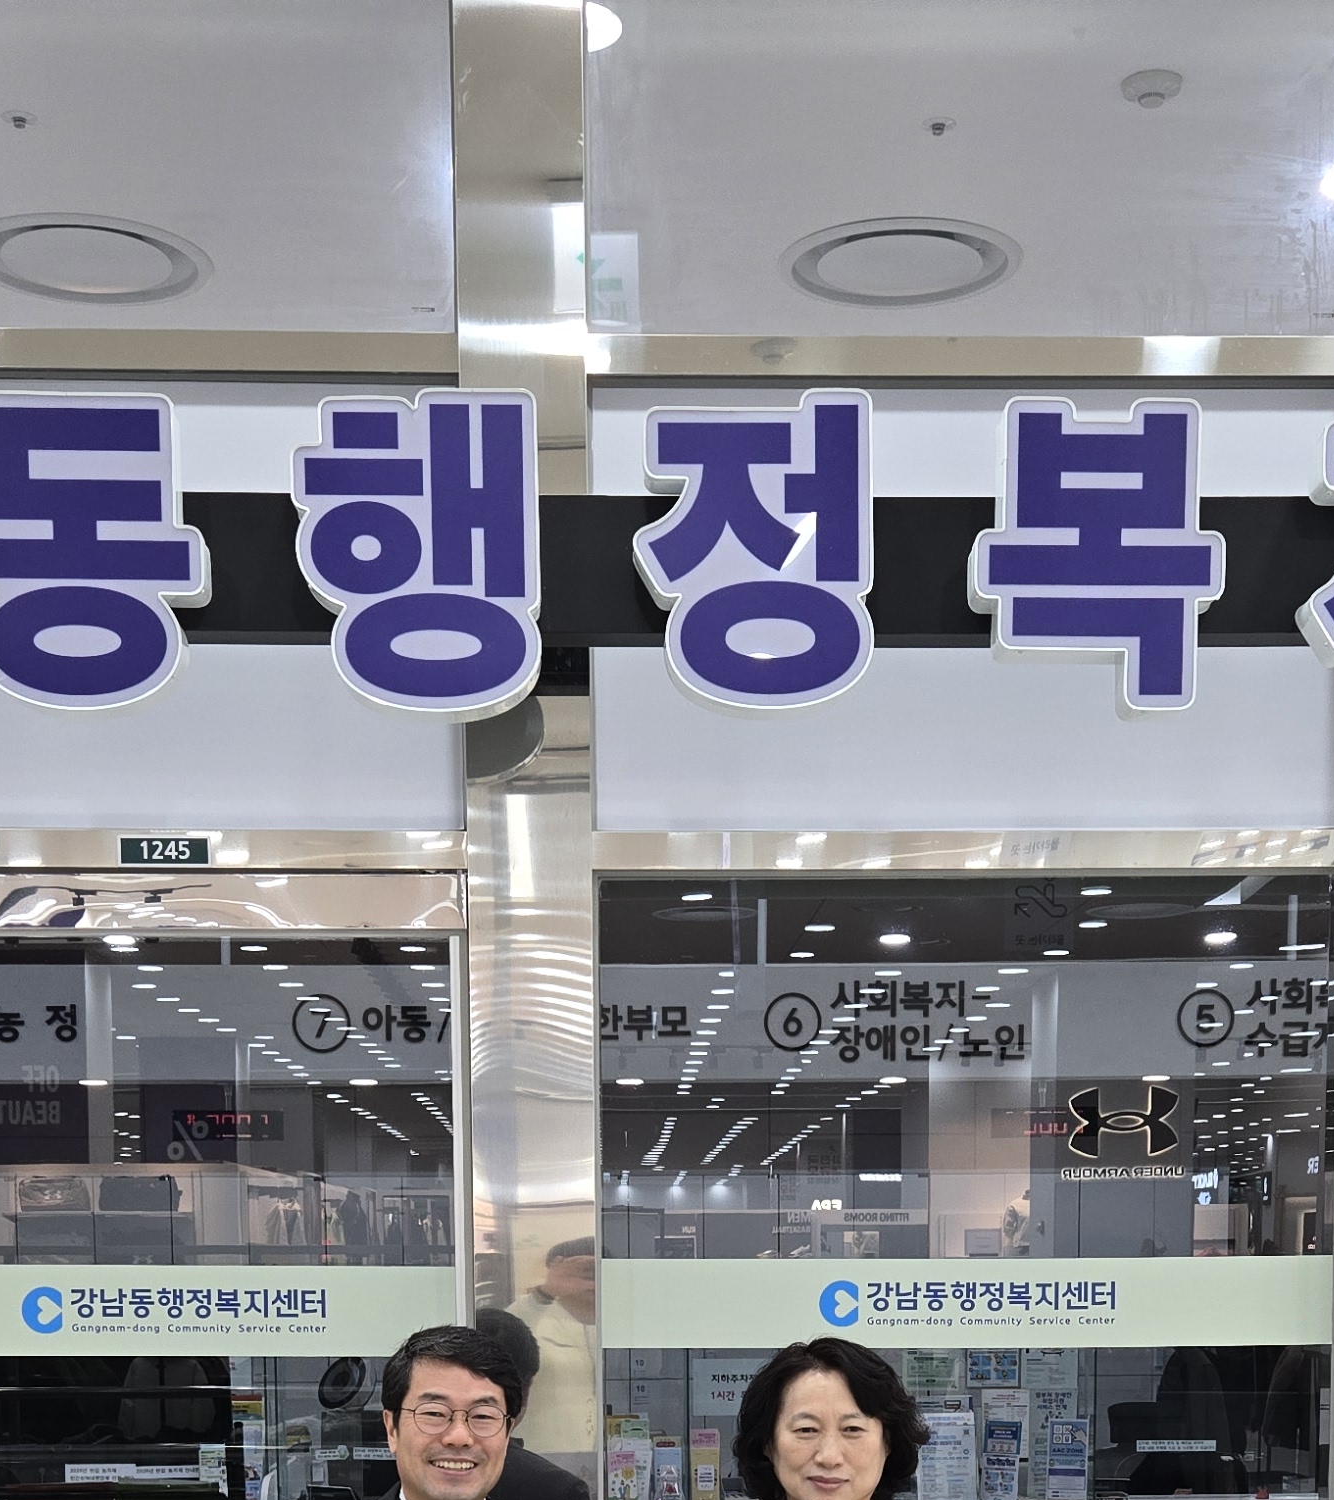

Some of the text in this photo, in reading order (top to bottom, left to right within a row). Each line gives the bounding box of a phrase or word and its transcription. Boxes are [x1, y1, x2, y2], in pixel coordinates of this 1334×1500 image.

[139, 839, 192, 860] 1245
[71, 1288, 326, 1318] 강남동행정복지센터
[867, 1281, 1115, 1311] 강남동행정복지센터
[72, 1324, 159, 1333] Gangnam-dong
[168, 1324, 230, 1333] Community
[239, 1324, 281, 1332] Service
[867, 1317, 952, 1326] Gangnam-dong
[960, 1317, 1022, 1326] Community
[1030, 1317, 1070, 1325] Service
[711, 1390, 735, 1402] 1시간
